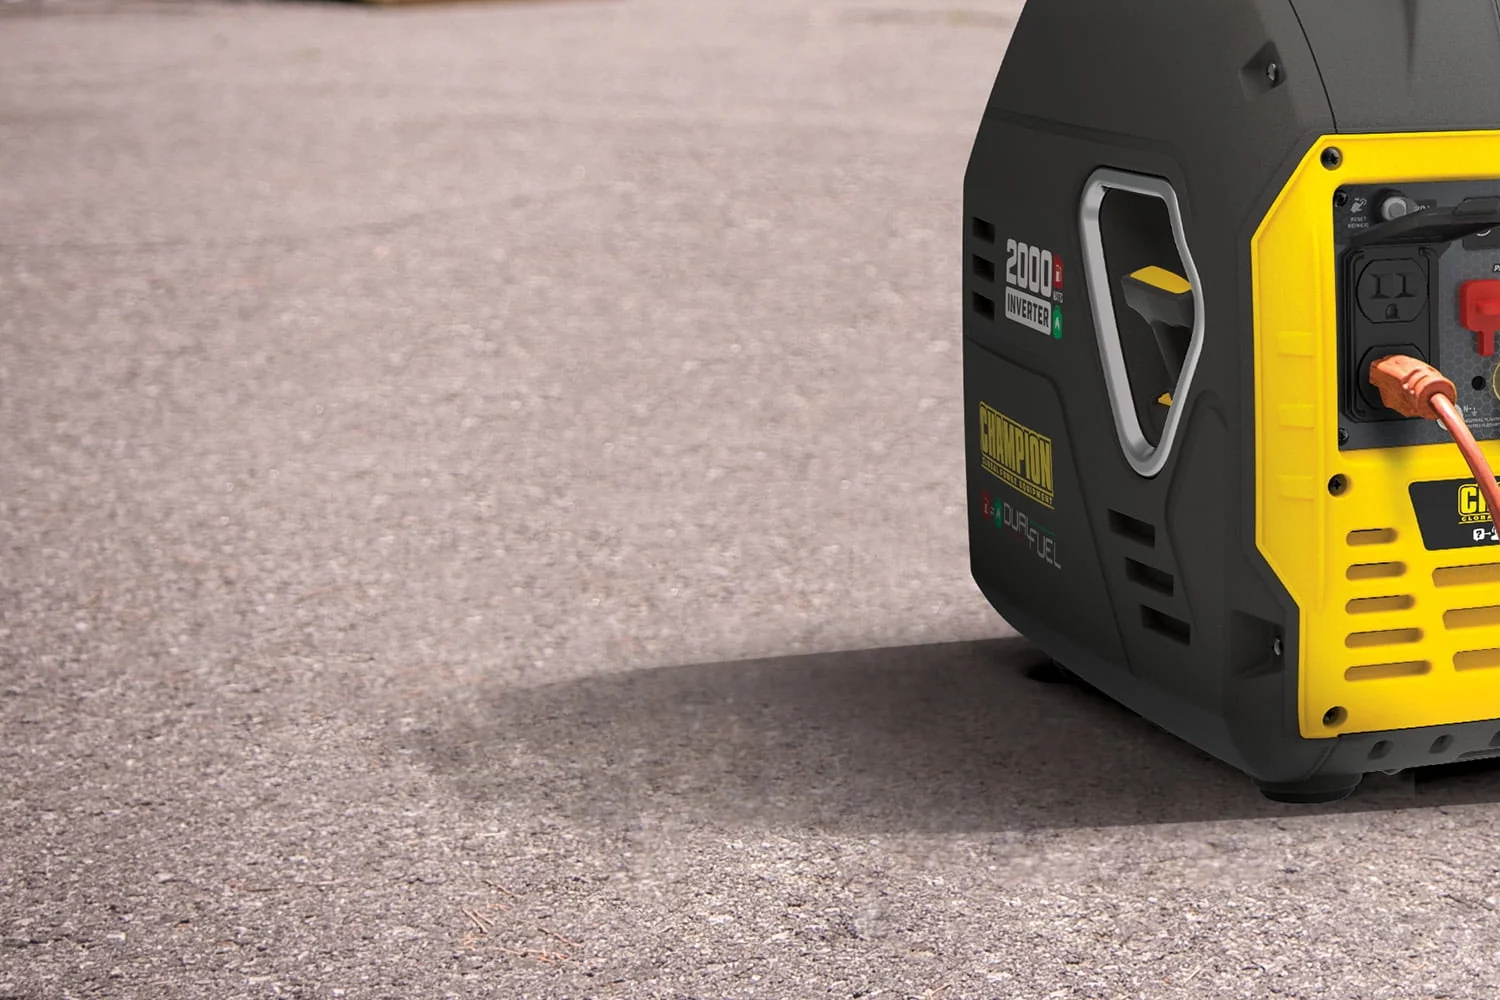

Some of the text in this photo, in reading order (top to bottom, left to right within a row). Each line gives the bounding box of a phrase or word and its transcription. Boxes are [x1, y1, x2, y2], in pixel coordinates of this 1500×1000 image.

[1006, 238, 1052, 297] 2000
[1007, 292, 1049, 328] INVERTER
[980, 404, 1053, 492] CHAMPION
[1004, 502, 1061, 570] DUAL FUEL
[1461, 514, 1493, 522] GLOBA
